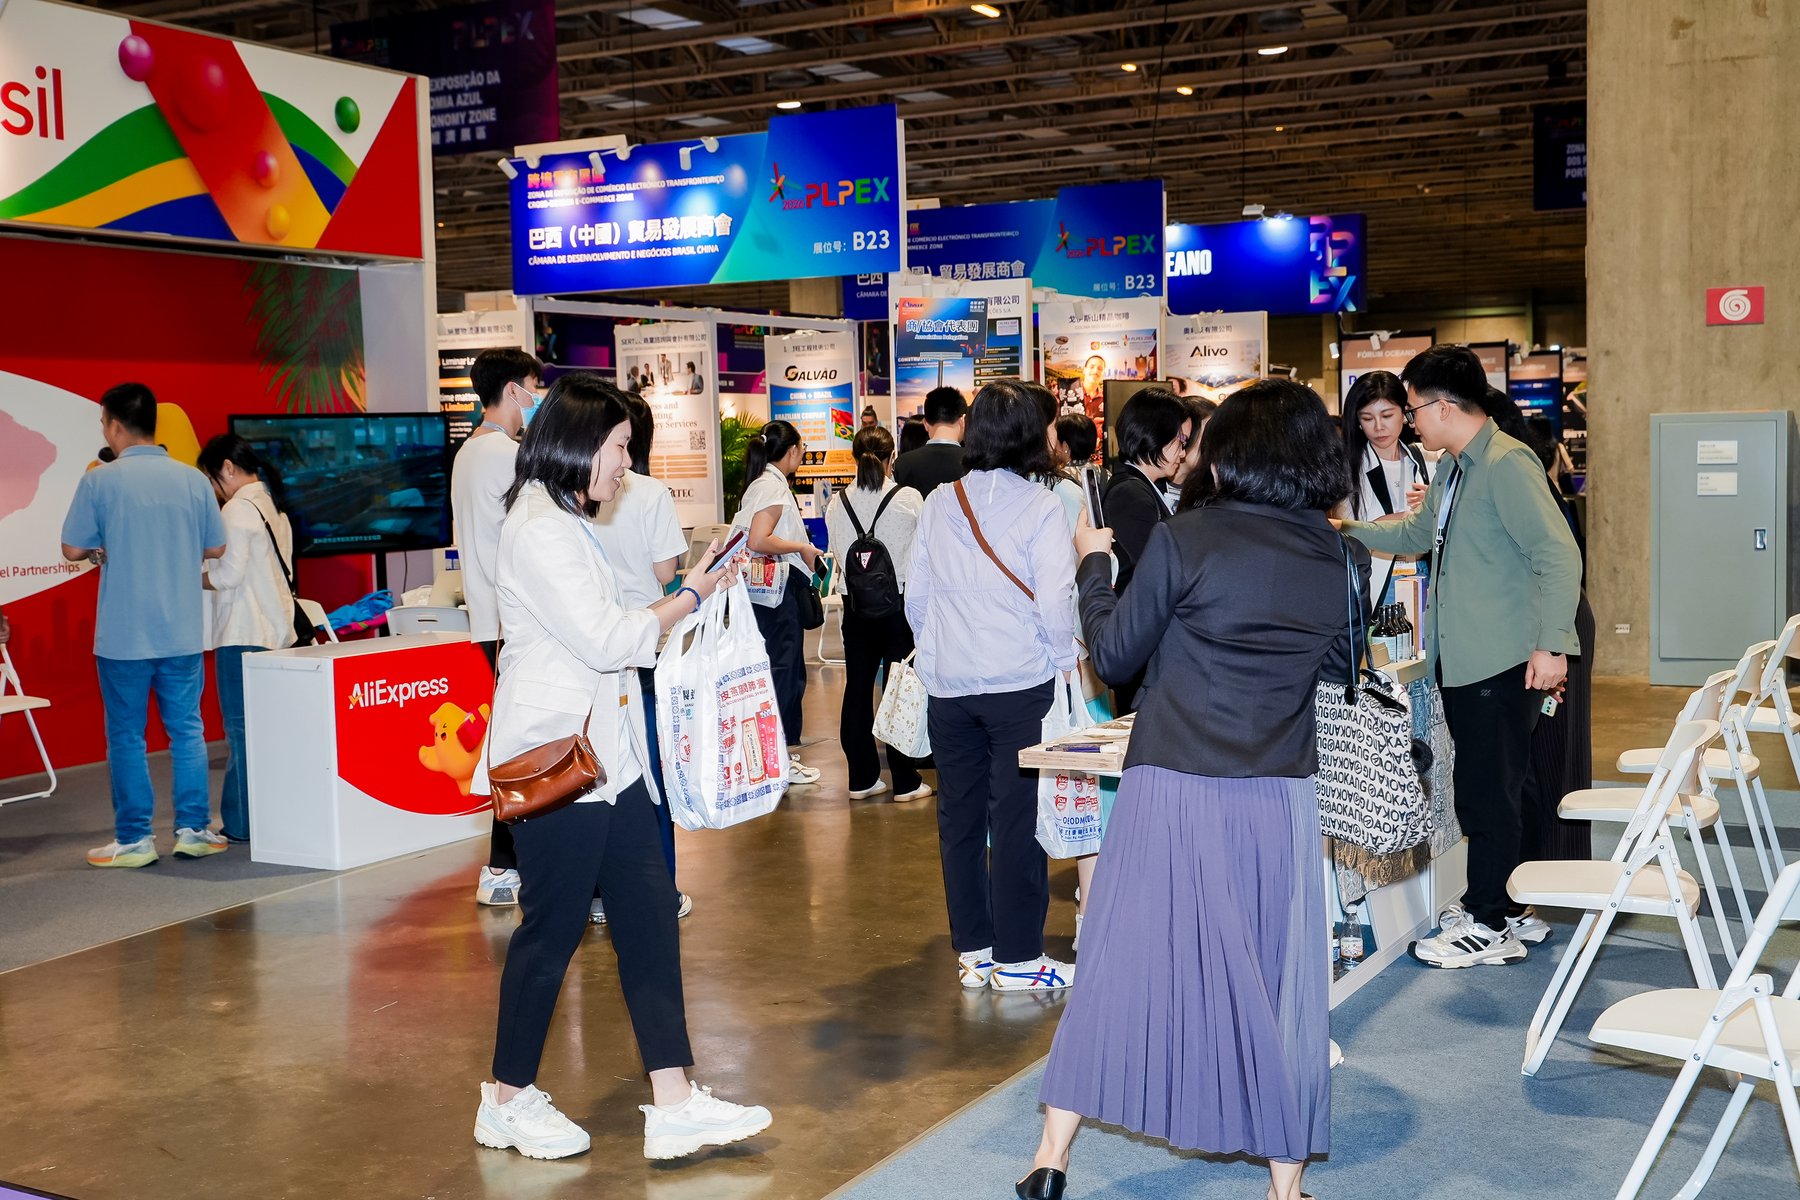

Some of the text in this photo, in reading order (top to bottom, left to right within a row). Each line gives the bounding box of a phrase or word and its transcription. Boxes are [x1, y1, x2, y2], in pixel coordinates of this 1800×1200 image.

[0, 66, 64, 140] sil
[468, 107, 497, 123] ZONE
[805, 176, 890, 209] PLPEX
[853, 229, 890, 251] B23
[1086, 234, 1156, 257] PLPEX
[1124, 273, 1156, 290] B23
[1190, 345, 1228, 357] Alivo
[785, 365, 838, 382] GALVÃO
[12, 562, 81, 578] Partnerships
[348, 677, 449, 710] AliExpress
